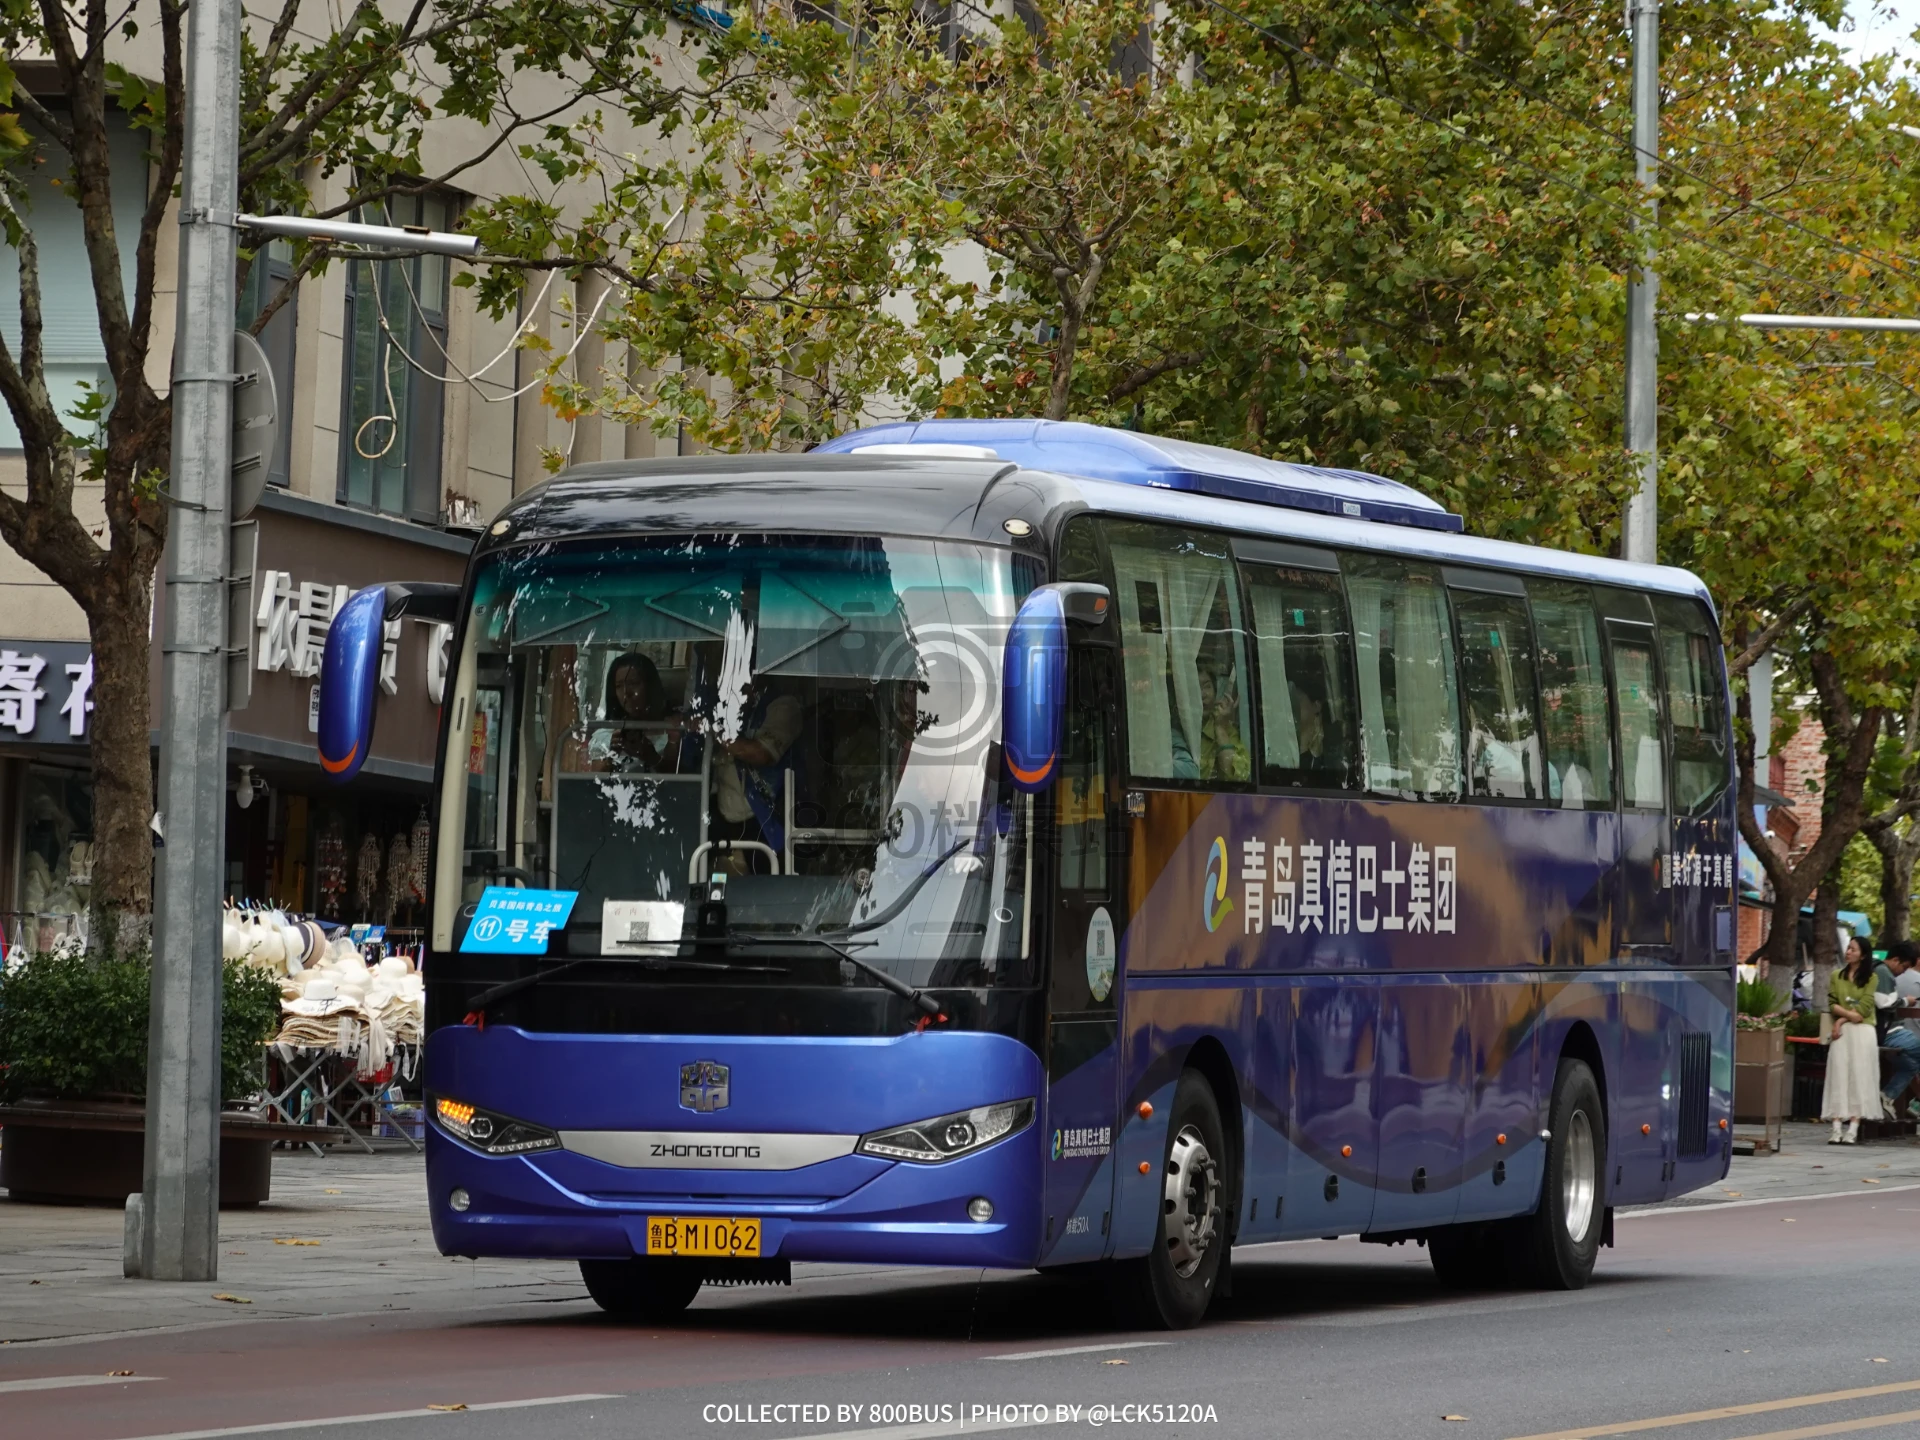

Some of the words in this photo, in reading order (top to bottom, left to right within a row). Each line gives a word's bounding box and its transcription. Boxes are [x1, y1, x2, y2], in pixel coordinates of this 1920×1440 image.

[1672, 850, 1733, 889] 美好源于真情
[1241, 836, 1457, 935] 青岛真情巴士集团
[650, 1144, 761, 1158] ZHONGTONG
[1063, 1127, 1111, 1148] 青岛真情巴士集团
